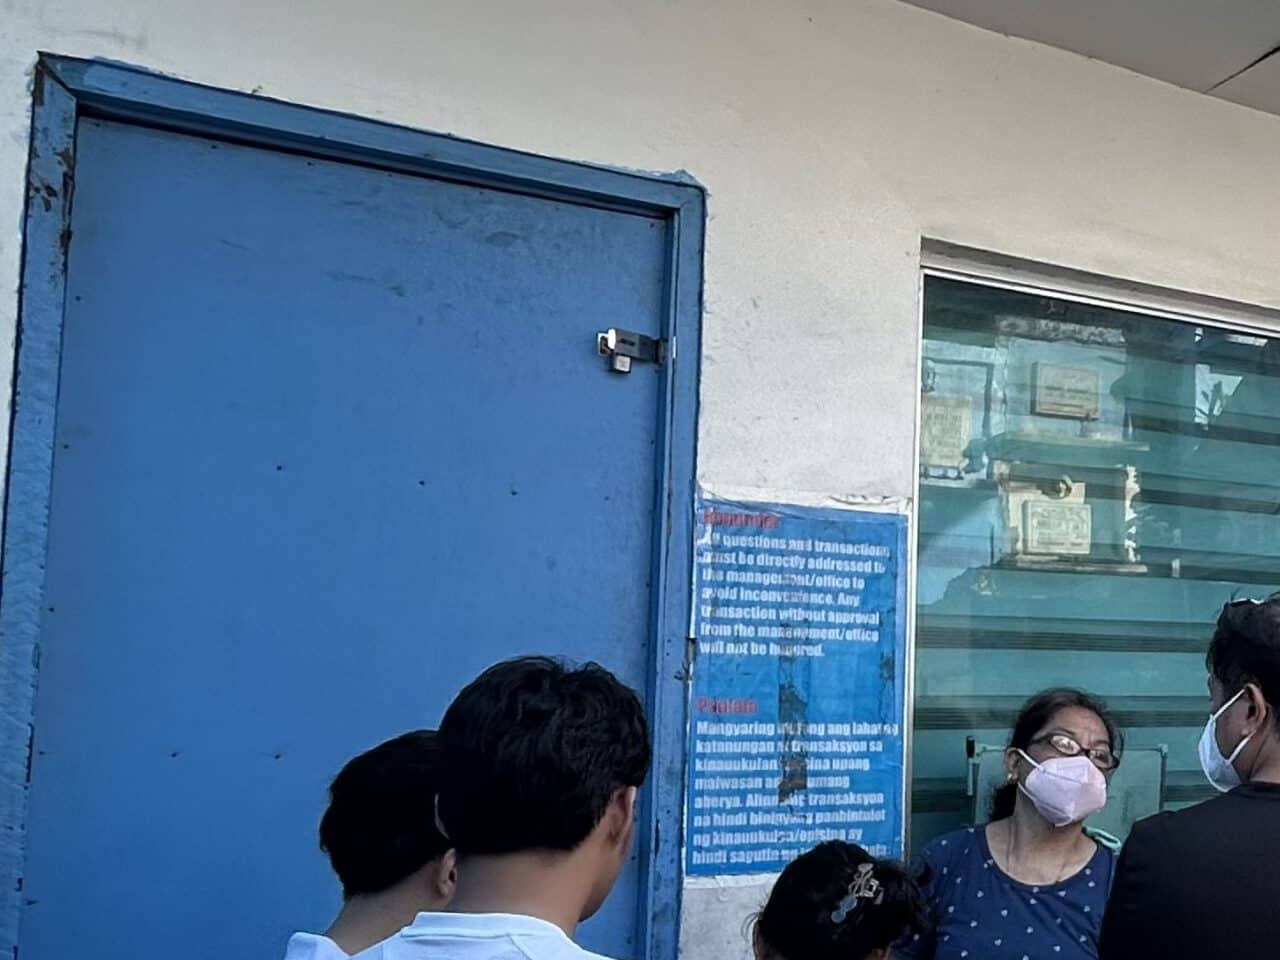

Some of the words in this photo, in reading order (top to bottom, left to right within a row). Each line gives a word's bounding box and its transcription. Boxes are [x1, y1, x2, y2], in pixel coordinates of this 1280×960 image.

[723, 535, 786, 550] questions
[738, 551, 754, 565] be
[757, 553, 806, 569] directly
[808, 557, 872, 573] addressed
[853, 577, 865, 590] to
[837, 592, 860, 607] Any
[779, 608, 826, 622] without
[828, 611, 879, 625] approval
[700, 623, 732, 636] from
[734, 624, 755, 637] the
[699, 641, 724, 654] will
[726, 642, 748, 655] not
[750, 642, 767, 655] be
[697, 721, 775, 736] Mangyaring
[827, 723, 851, 736] ang
[869, 741, 882, 752] sa
[832, 758, 870, 771] upang
[808, 792, 884, 806] transaksyon
[694, 815, 710, 827] na
[713, 812, 748, 827] hindi
[693, 834, 710, 848] ng
[692, 849, 728, 864] hindi
